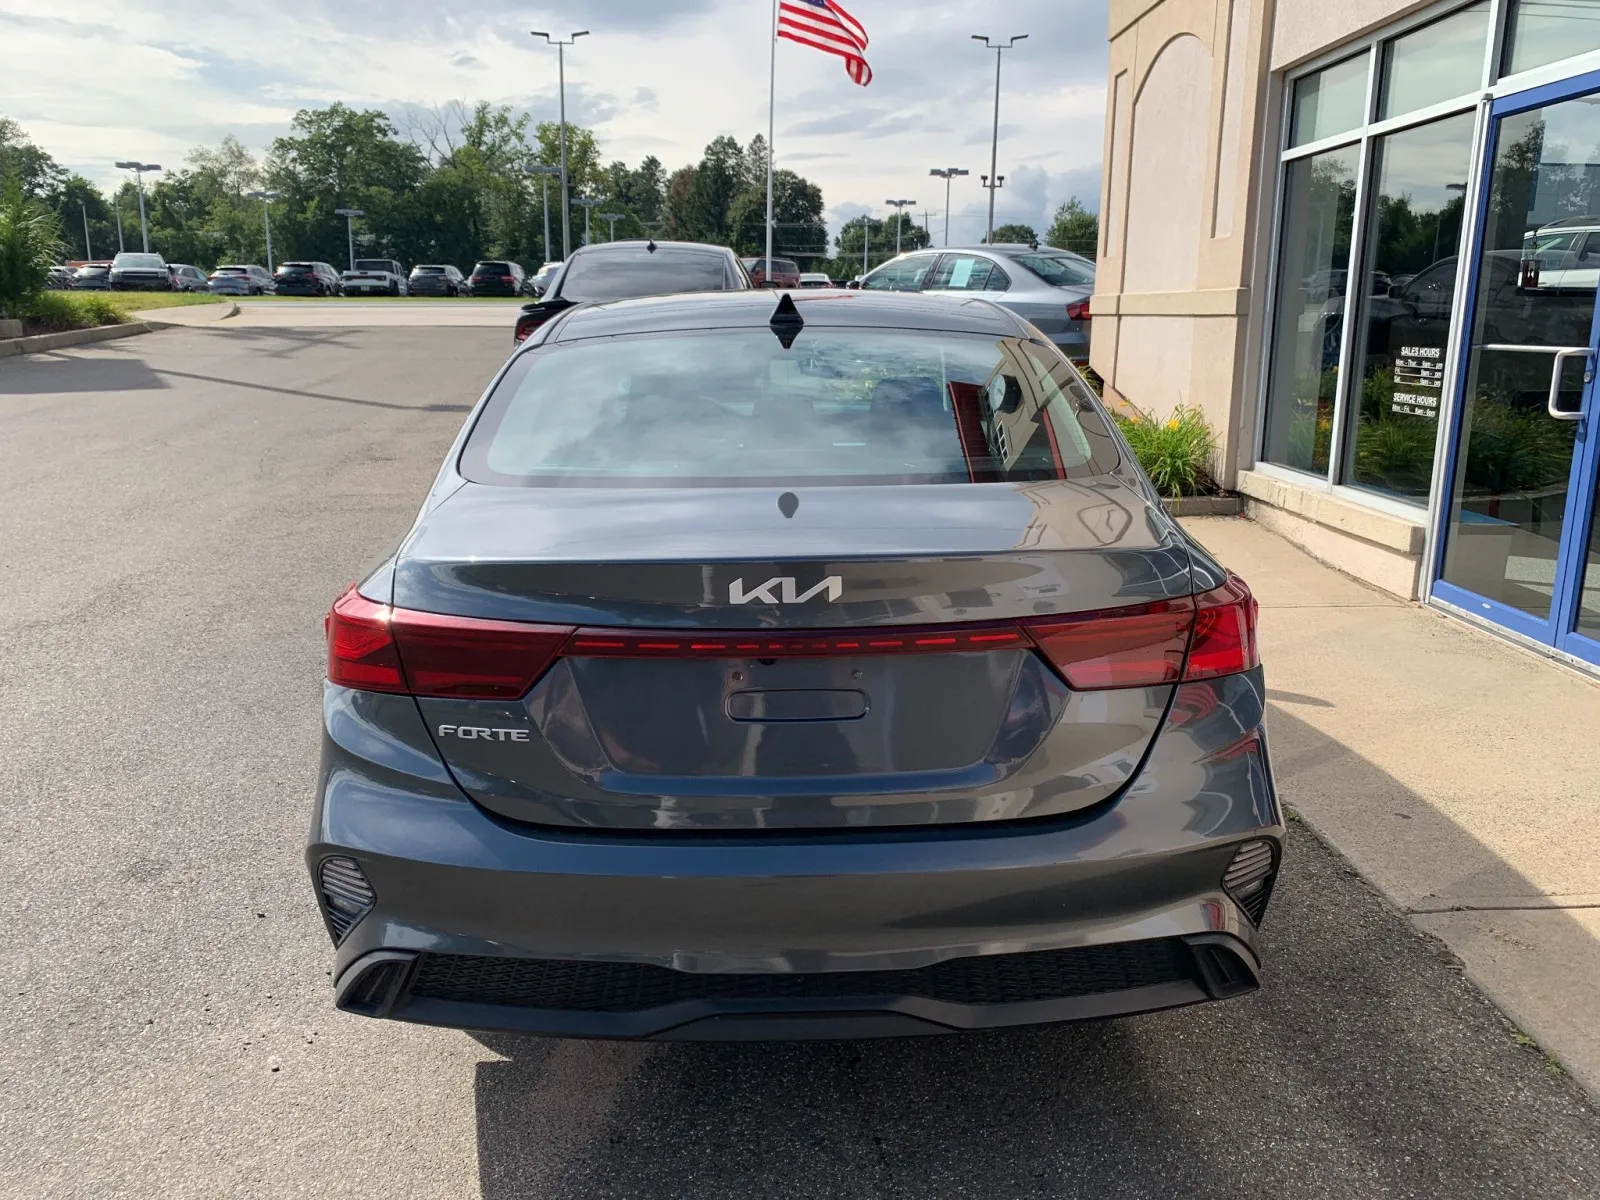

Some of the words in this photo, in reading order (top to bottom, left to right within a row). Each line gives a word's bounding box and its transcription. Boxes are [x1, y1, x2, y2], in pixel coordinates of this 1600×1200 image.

[1401, 347, 1419, 357] SALES
[1419, 347, 1440, 357] HOURS
[1393, 393, 1416, 403] SERVICE
[1416, 396, 1437, 406] HOURS
[729, 575, 842, 604] KIA
[438, 724, 529, 742] FORTE
